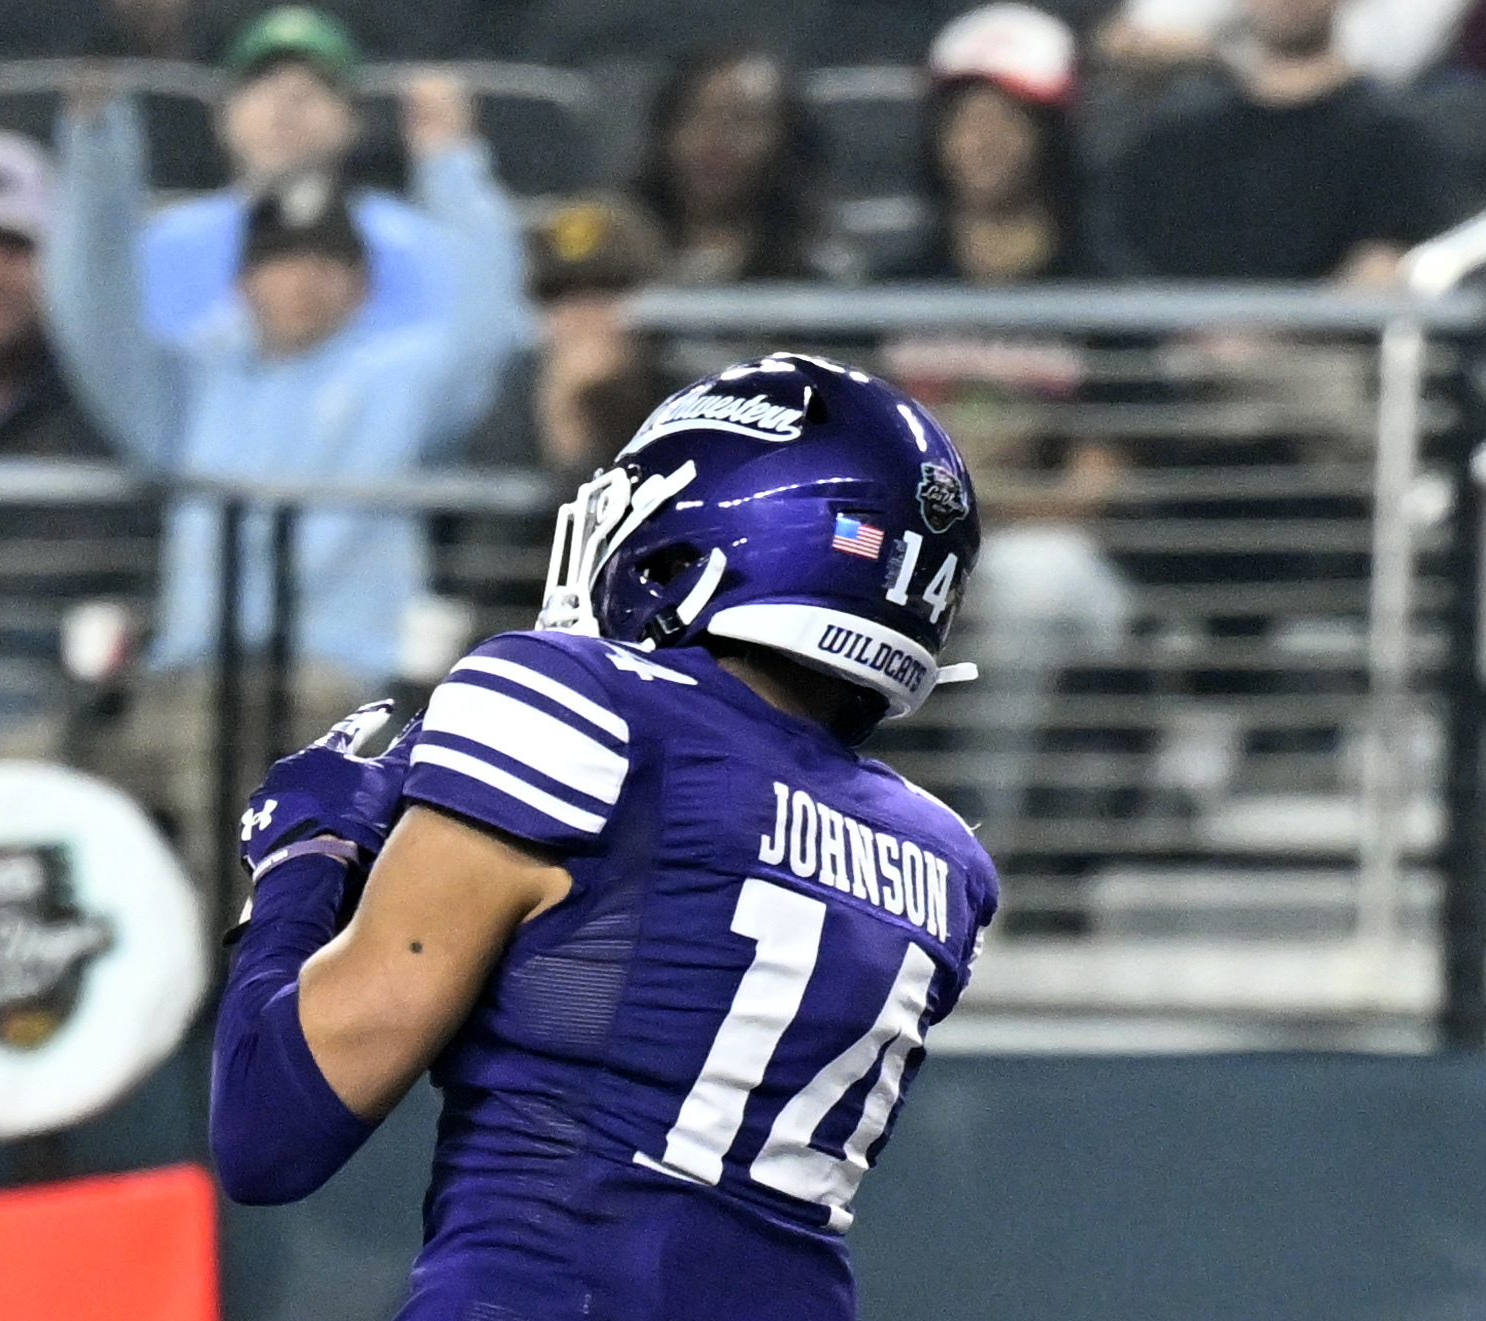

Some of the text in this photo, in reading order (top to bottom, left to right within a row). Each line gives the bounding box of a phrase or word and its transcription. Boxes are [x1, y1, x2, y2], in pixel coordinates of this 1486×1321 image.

[885, 529, 958, 624] 14
[818, 624, 927, 693] WILDCATS
[758, 781, 949, 944] JOHNSON
[632, 877, 936, 1234] 14
